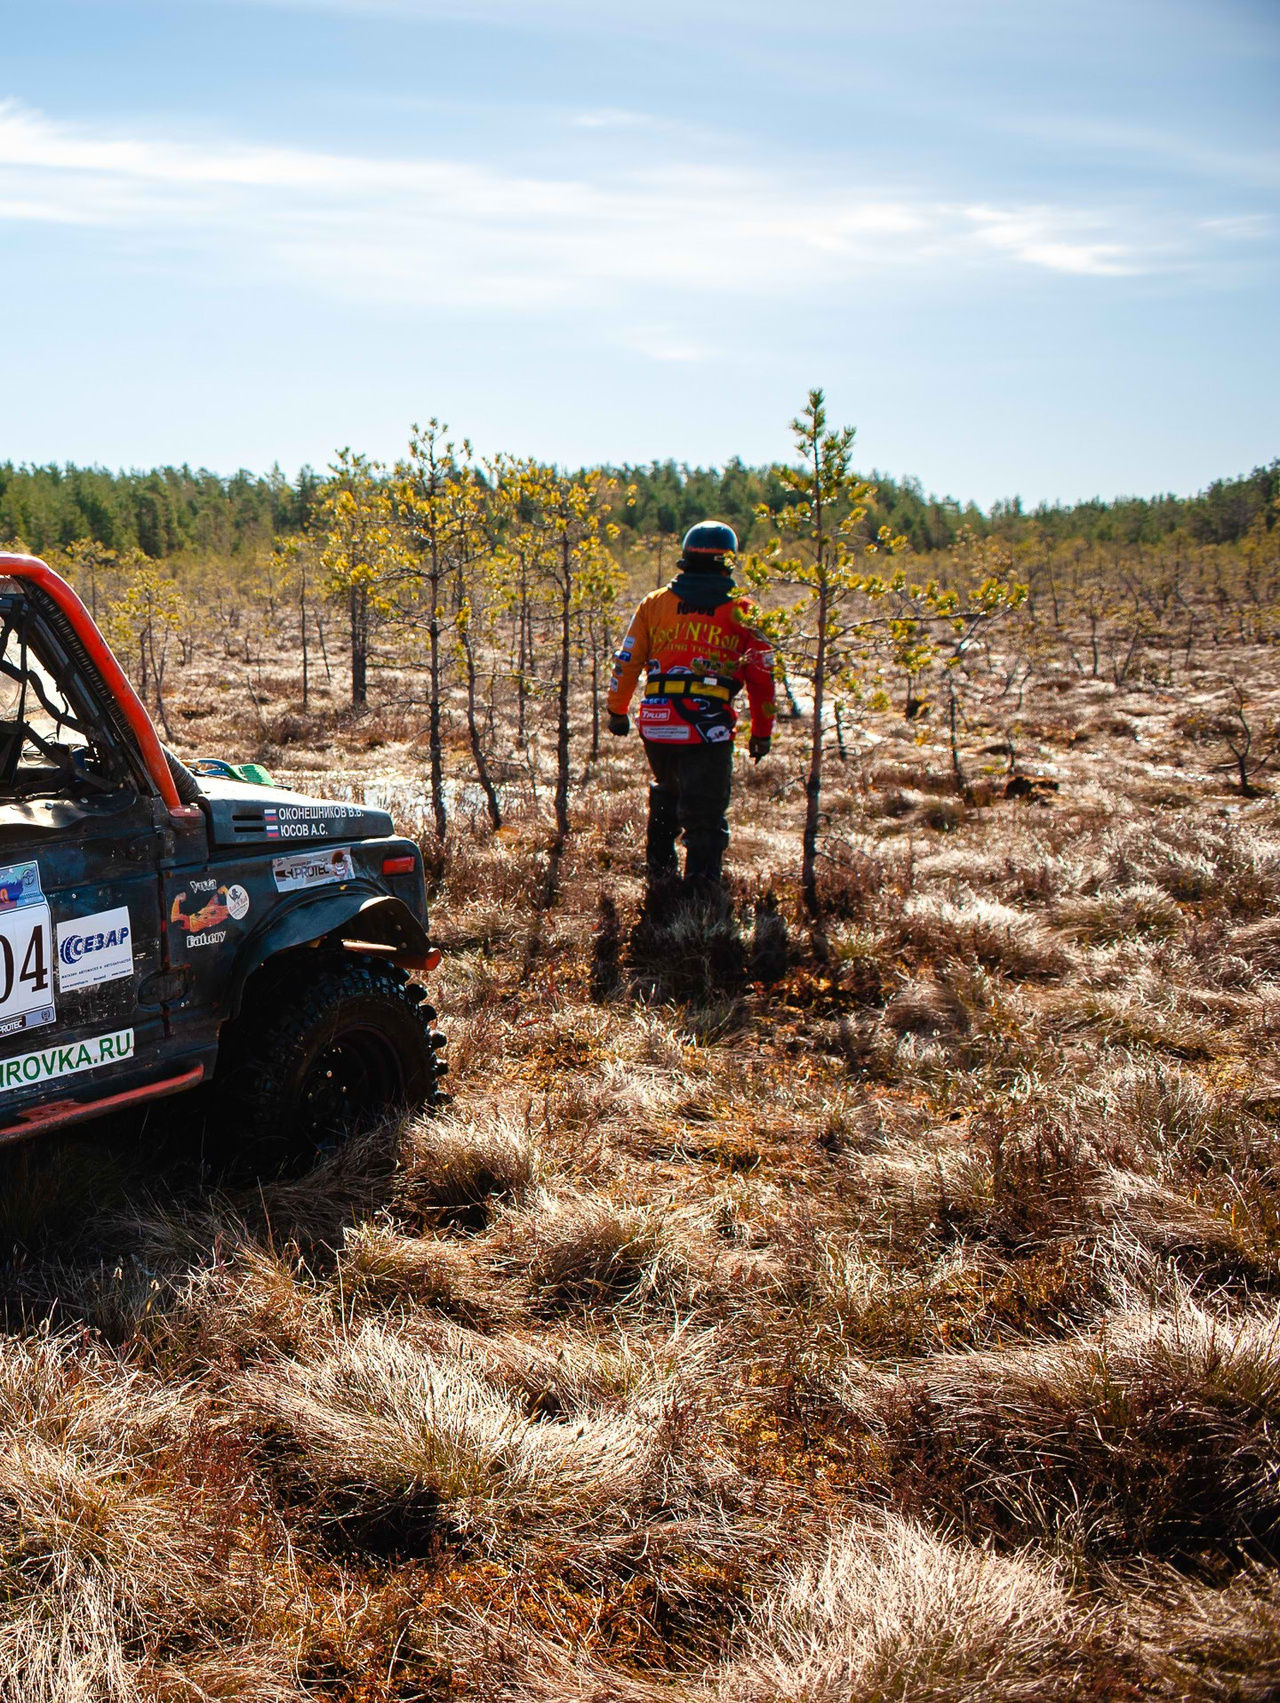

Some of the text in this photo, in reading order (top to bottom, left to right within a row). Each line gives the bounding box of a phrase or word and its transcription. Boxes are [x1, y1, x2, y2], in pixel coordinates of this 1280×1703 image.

[279, 806, 347, 820] ОКОНЕШНИКОВ
[280, 823, 328, 837] ЮСОВ А.С.
